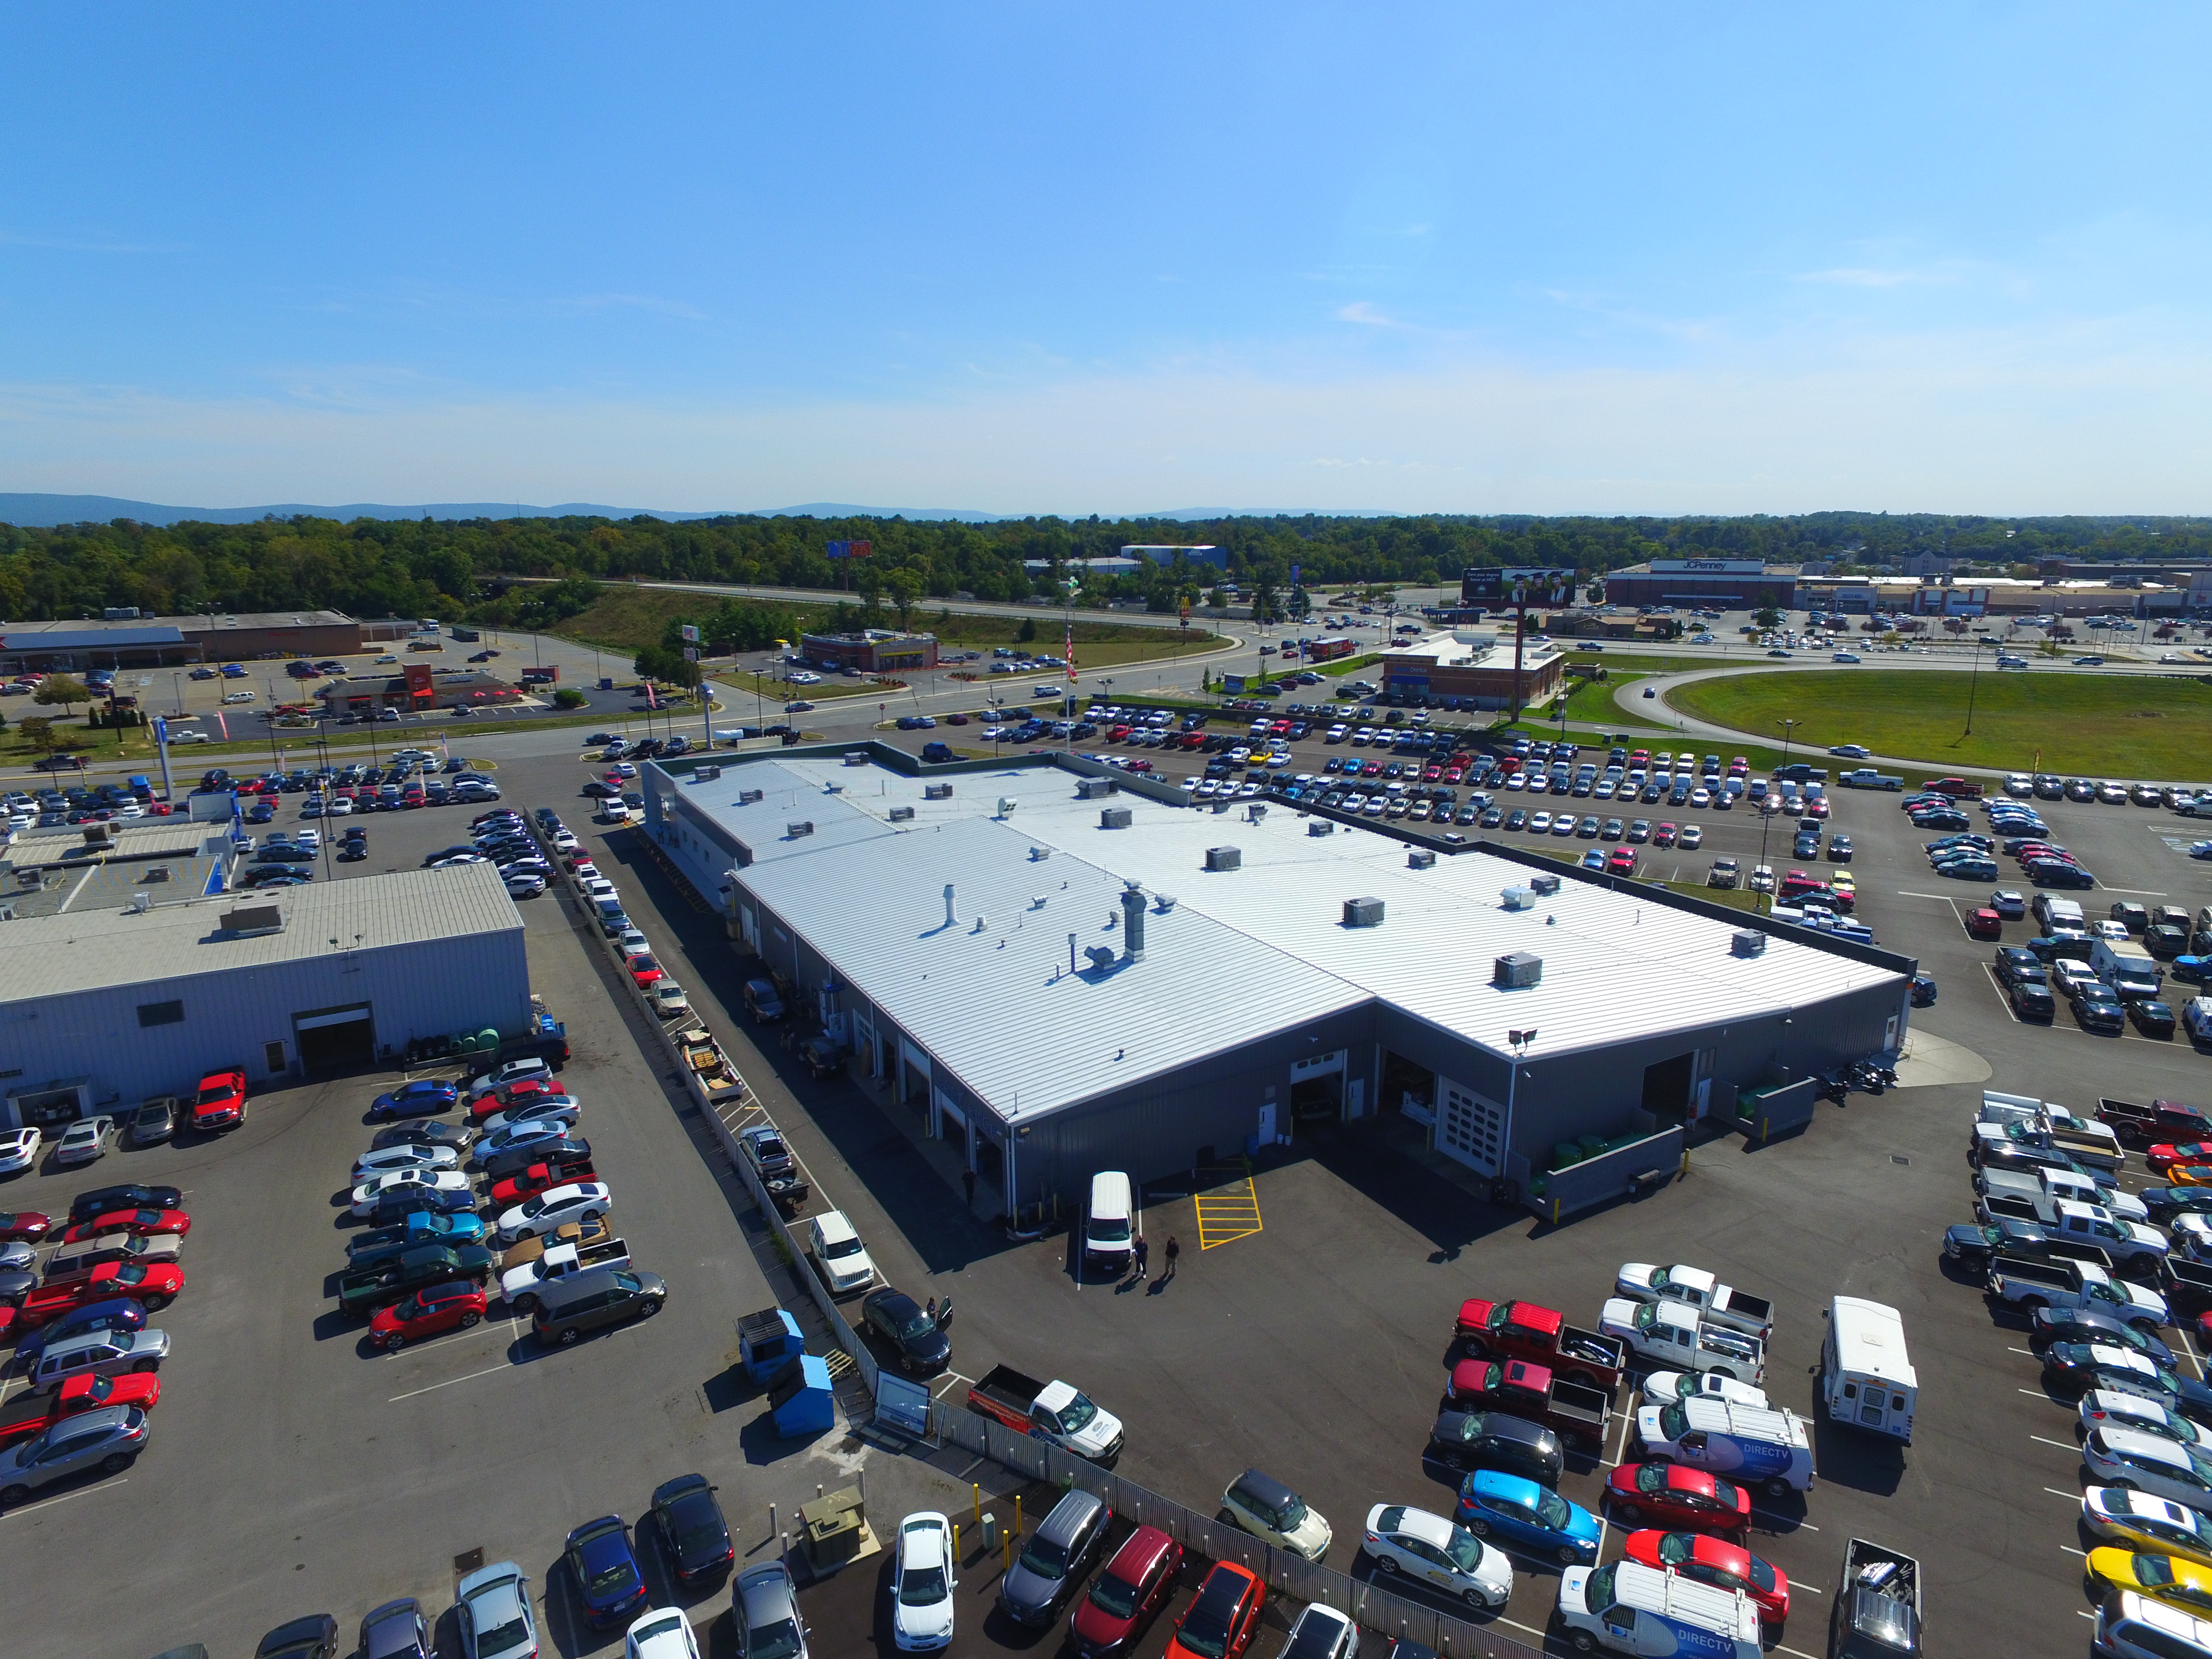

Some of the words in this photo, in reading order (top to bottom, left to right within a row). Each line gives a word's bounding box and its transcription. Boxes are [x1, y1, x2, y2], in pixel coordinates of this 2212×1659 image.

[1683, 561, 1726, 571] JCPenney
[1744, 1444, 1788, 1459] DIRECTV
[1678, 1629, 1731, 1653] DIRECTV
